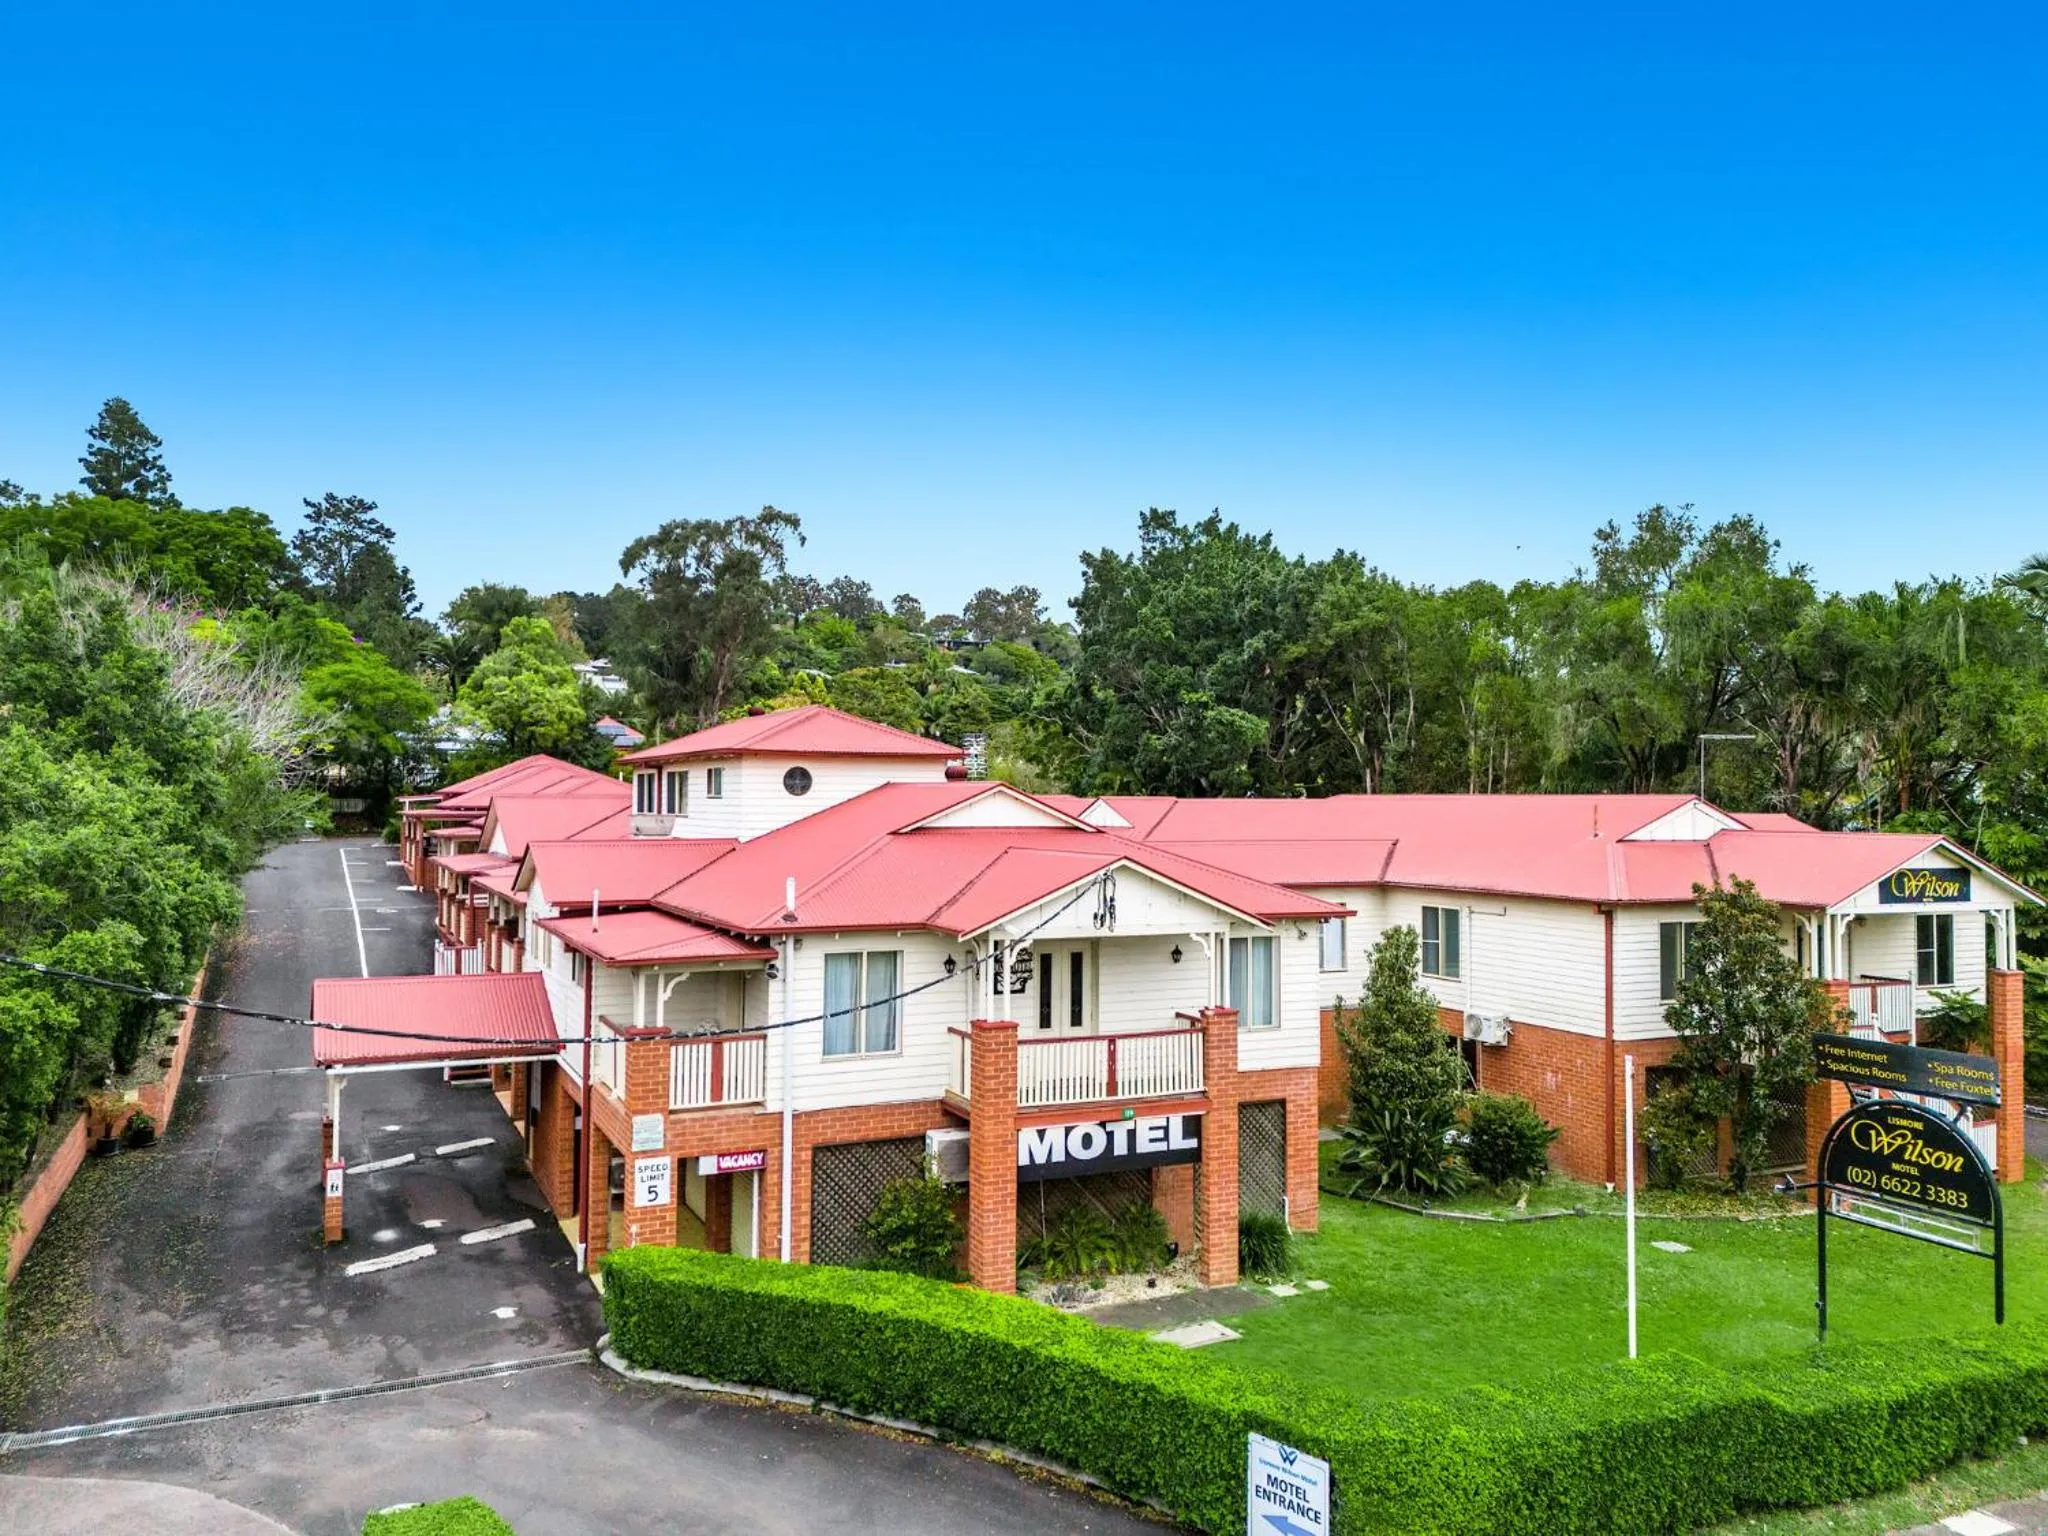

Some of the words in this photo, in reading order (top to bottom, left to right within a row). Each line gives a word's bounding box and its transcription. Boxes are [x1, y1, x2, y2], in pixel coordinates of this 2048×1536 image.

[1892, 869, 1960, 898] Wilson
[1825, 1044, 1846, 1056] Free
[1847, 1048, 1888, 1064] Internet
[1827, 1059, 1870, 1076] Spacious
[1872, 1067, 1907, 1082] Rooms
[1934, 1062, 1954, 1075] Spa
[1956, 1065, 1994, 1080] Rooms
[1935, 1077, 1959, 1089] Free
[1887, 1116, 1924, 1130] LISMORE
[1019, 1117, 1198, 1167] MOTEL
[1851, 1119, 1964, 1172] Wilson
[638, 1163, 669, 1173] SPEED
[719, 1152, 764, 1169] VACANCY
[1891, 1162, 1920, 1175] MOTEL
[640, 1174, 665, 1183] LIMIT
[1847, 1165, 1877, 1188] (02)
[1881, 1175, 1921, 1197] 6622
[1925, 1184, 1969, 1208] 3383
[647, 1185, 659, 1202] 5
[1266, 1473, 1310, 1503] MOTEL
[1255, 1485, 1322, 1525] ENTRANCE
